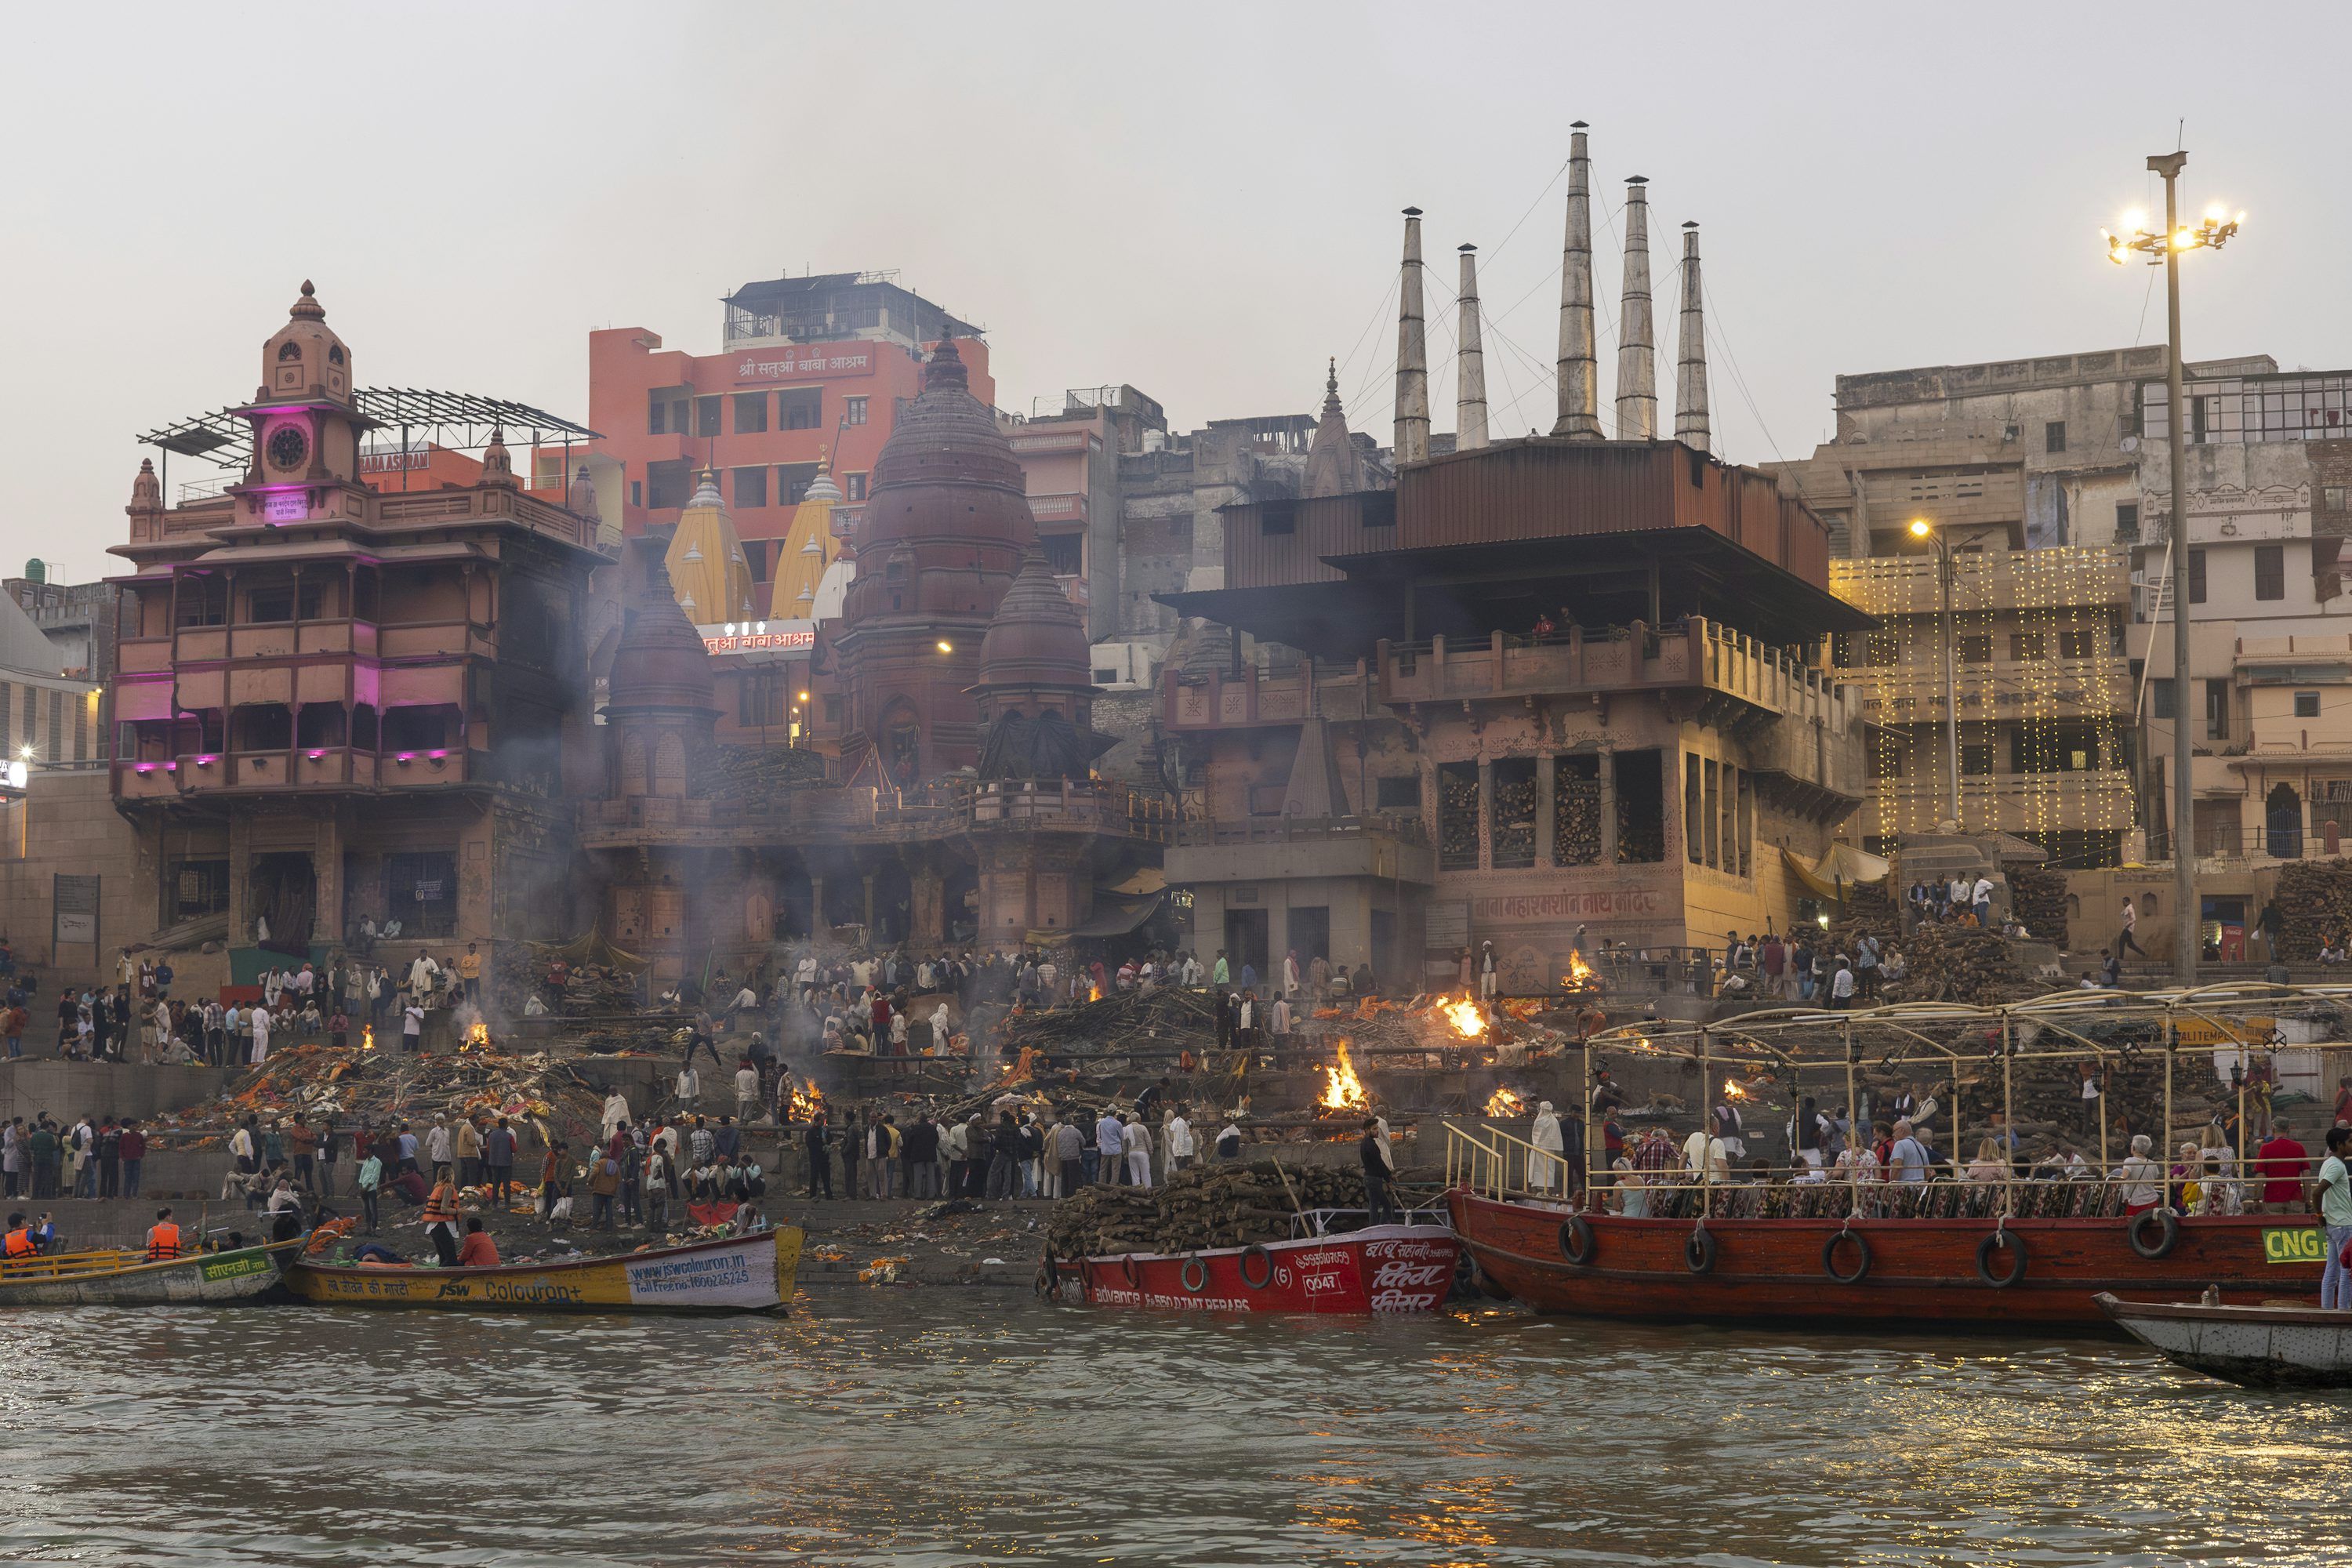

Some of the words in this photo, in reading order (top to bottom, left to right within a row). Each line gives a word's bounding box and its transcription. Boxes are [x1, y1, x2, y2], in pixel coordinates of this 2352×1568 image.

[739, 358, 756, 376] श्री
[799, 358, 826, 372] बाबा
[829, 355, 868, 369] आश्रम
[703, 636, 738, 655] तुआ
[741, 634, 772, 649] बाबा
[775, 632, 814, 646] आश्रम
[1583, 891, 1612, 914] नाथ
[2267, 1229, 2319, 1258] CNG
[367, 1279, 382, 1296] की
[435, 1284, 470, 1298] JSW
